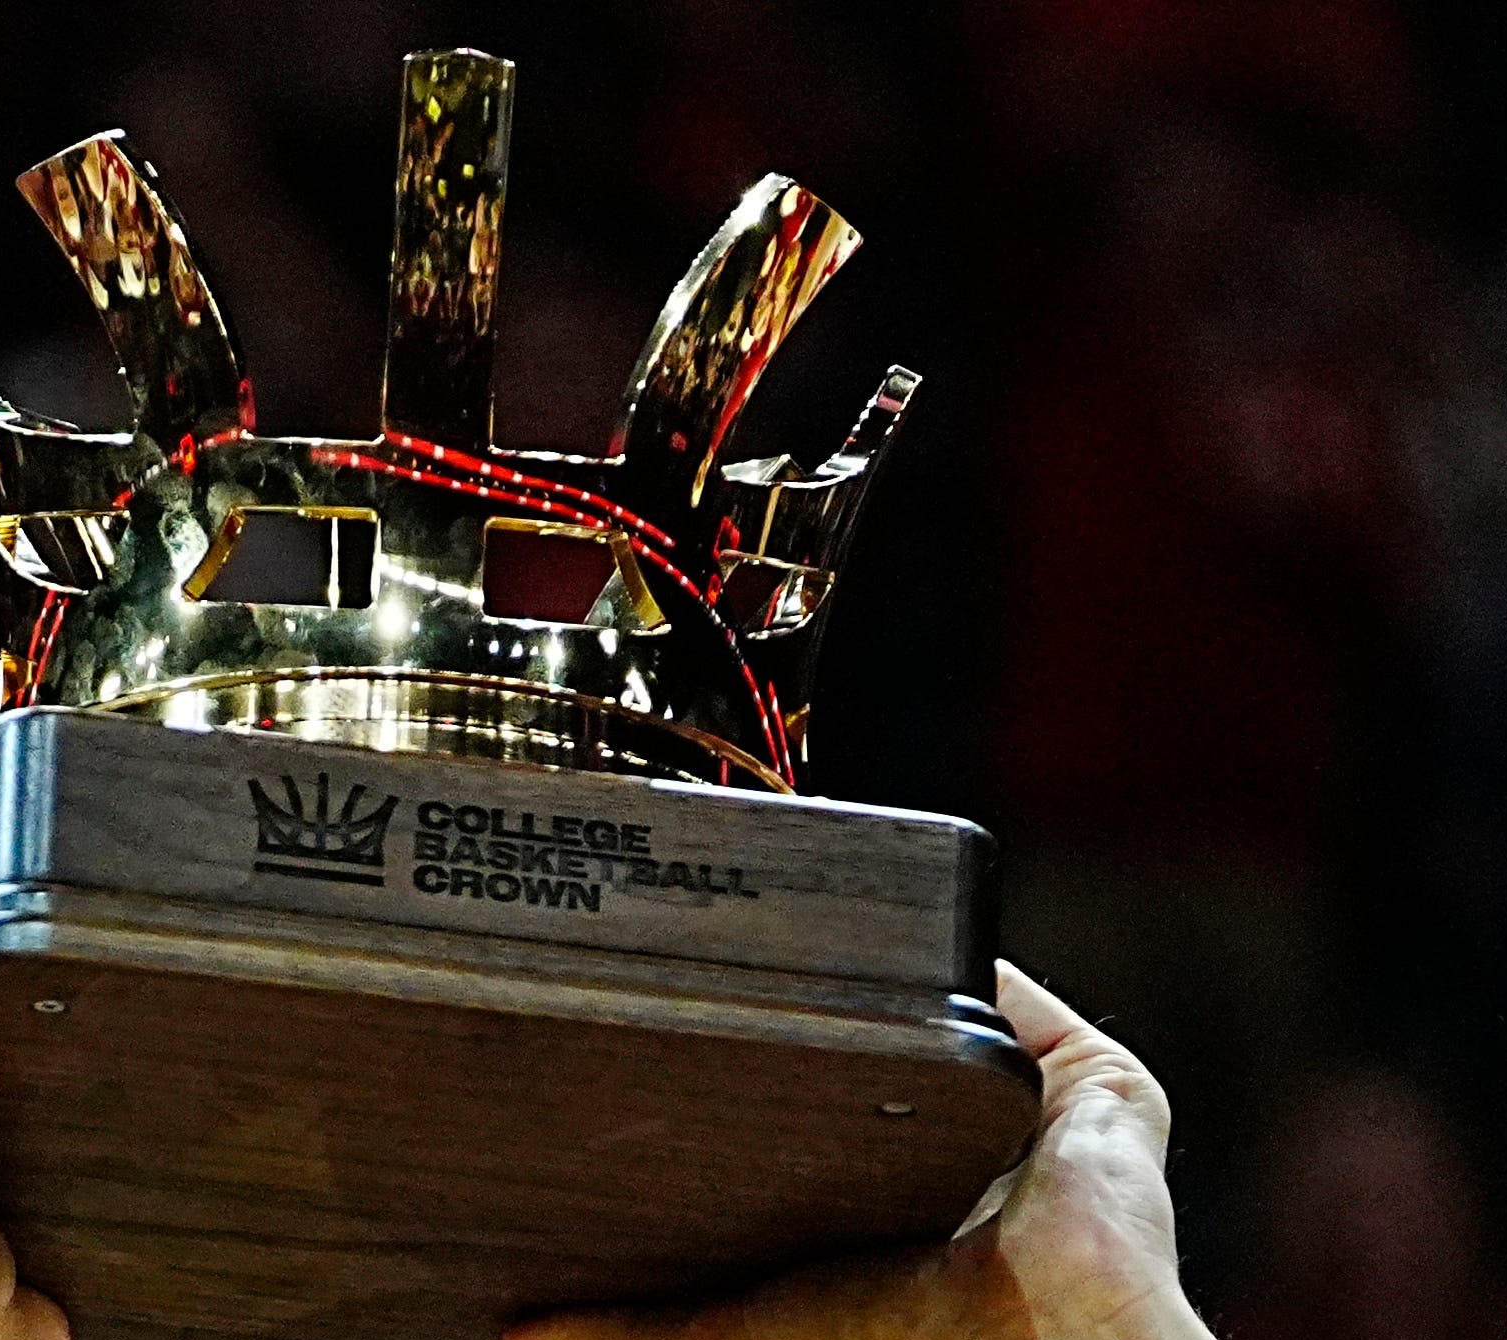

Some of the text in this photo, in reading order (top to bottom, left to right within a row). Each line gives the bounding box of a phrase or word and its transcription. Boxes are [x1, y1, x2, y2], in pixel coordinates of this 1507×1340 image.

[417, 800, 653, 855] COLLEGE
[412, 863, 602, 913] CROWN
[413, 831, 761, 900] BASKETBALL
